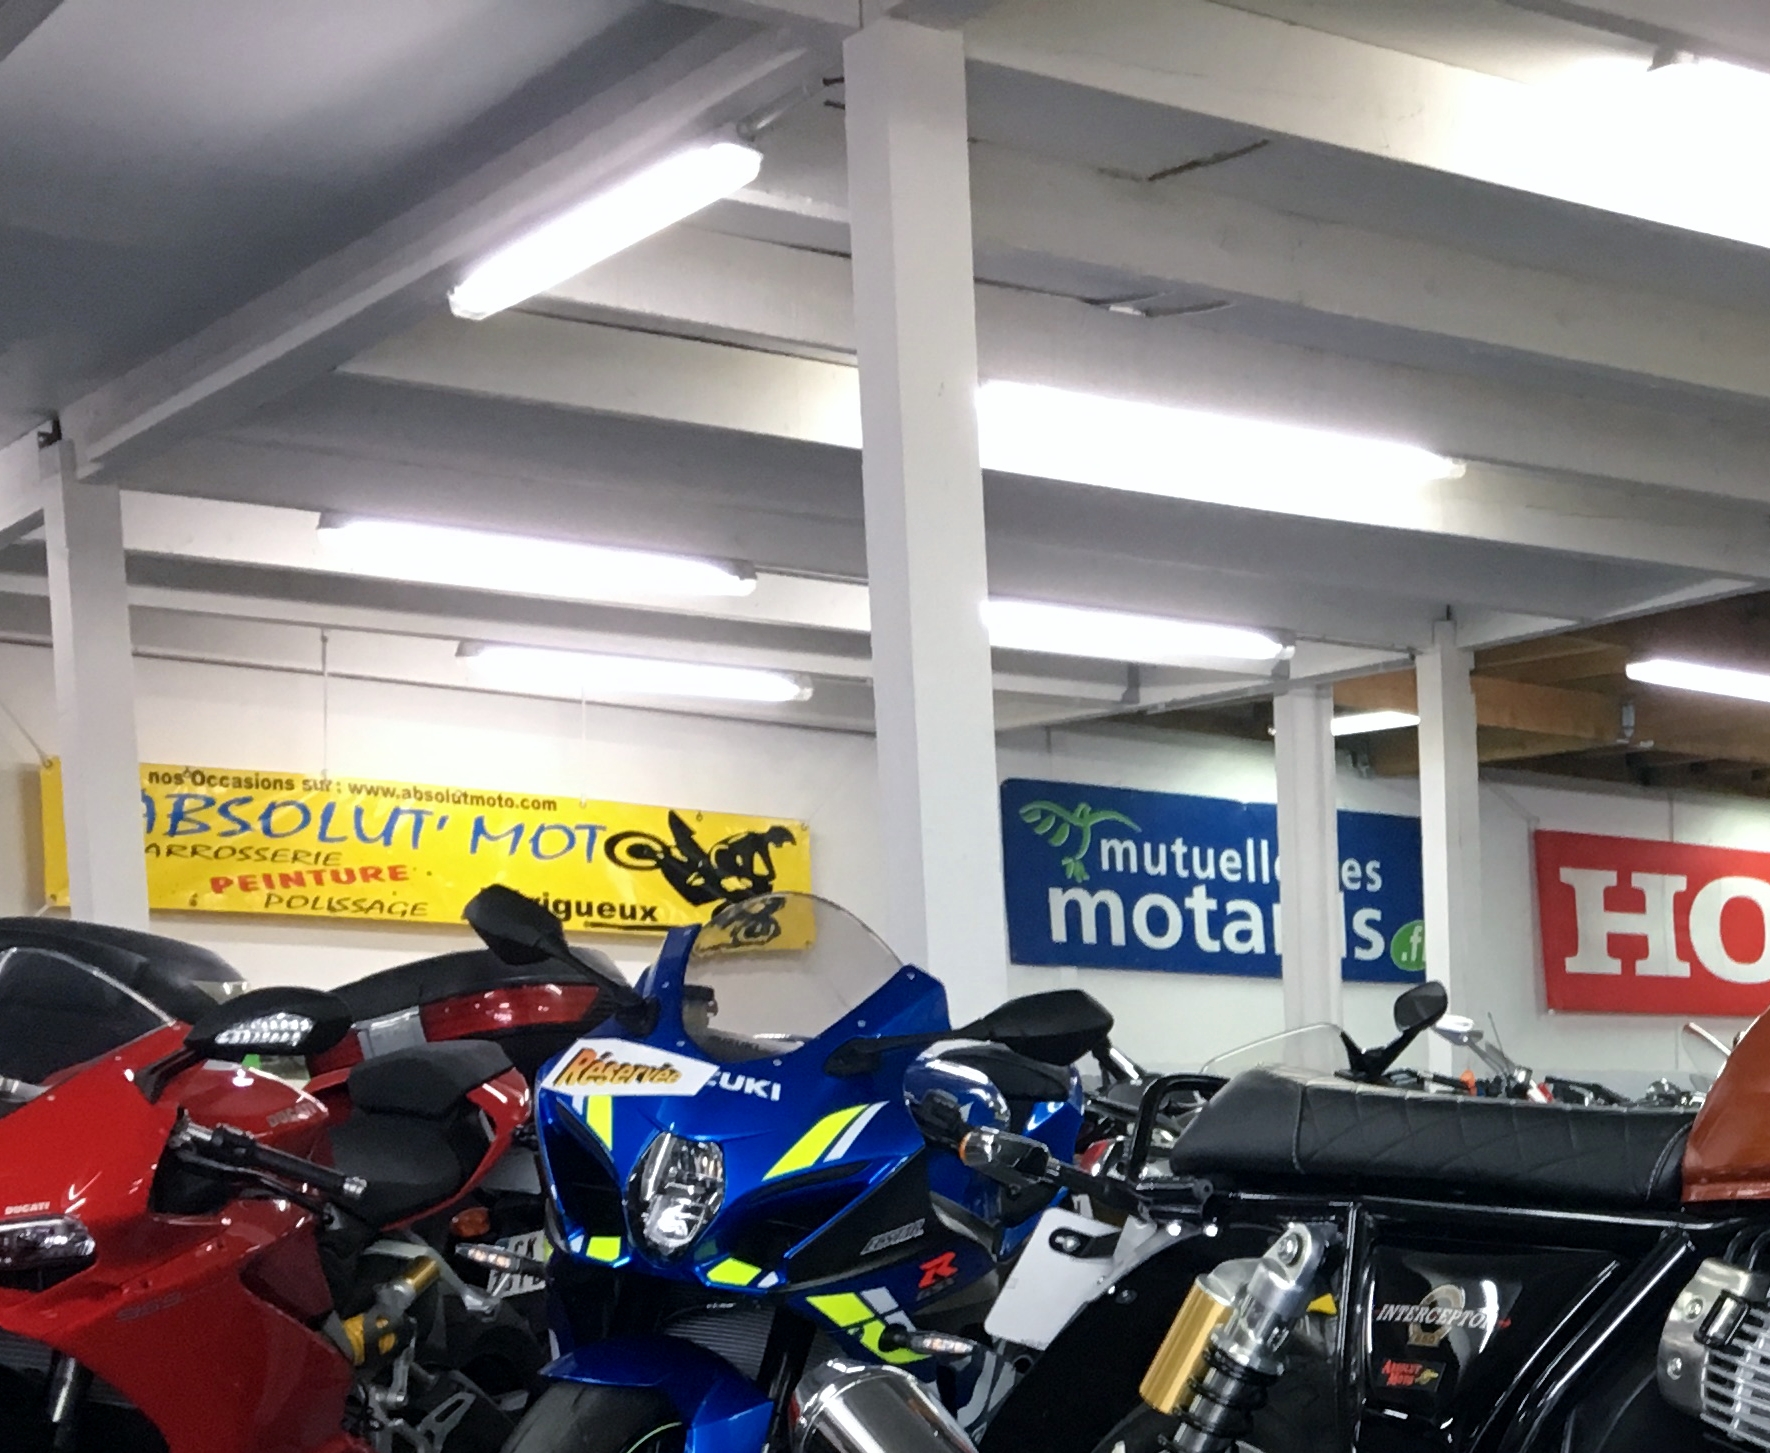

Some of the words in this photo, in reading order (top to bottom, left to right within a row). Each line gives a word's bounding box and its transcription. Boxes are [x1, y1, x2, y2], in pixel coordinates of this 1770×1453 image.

[147, 771, 185, 785] nos
[190, 769, 295, 792] Occasions
[348, 779, 558, 812] www.absolutmoto.com
[144, 842, 343, 867] ARROSSERIE
[209, 864, 411, 895] PEINTURE
[1341, 857, 1383, 892] es
[263, 890, 431, 917] POLISSAGE
[1048, 883, 1386, 962] motas
[553, 1047, 683, 1087] Réservée
[4, 1201, 51, 1216] DUCATI
